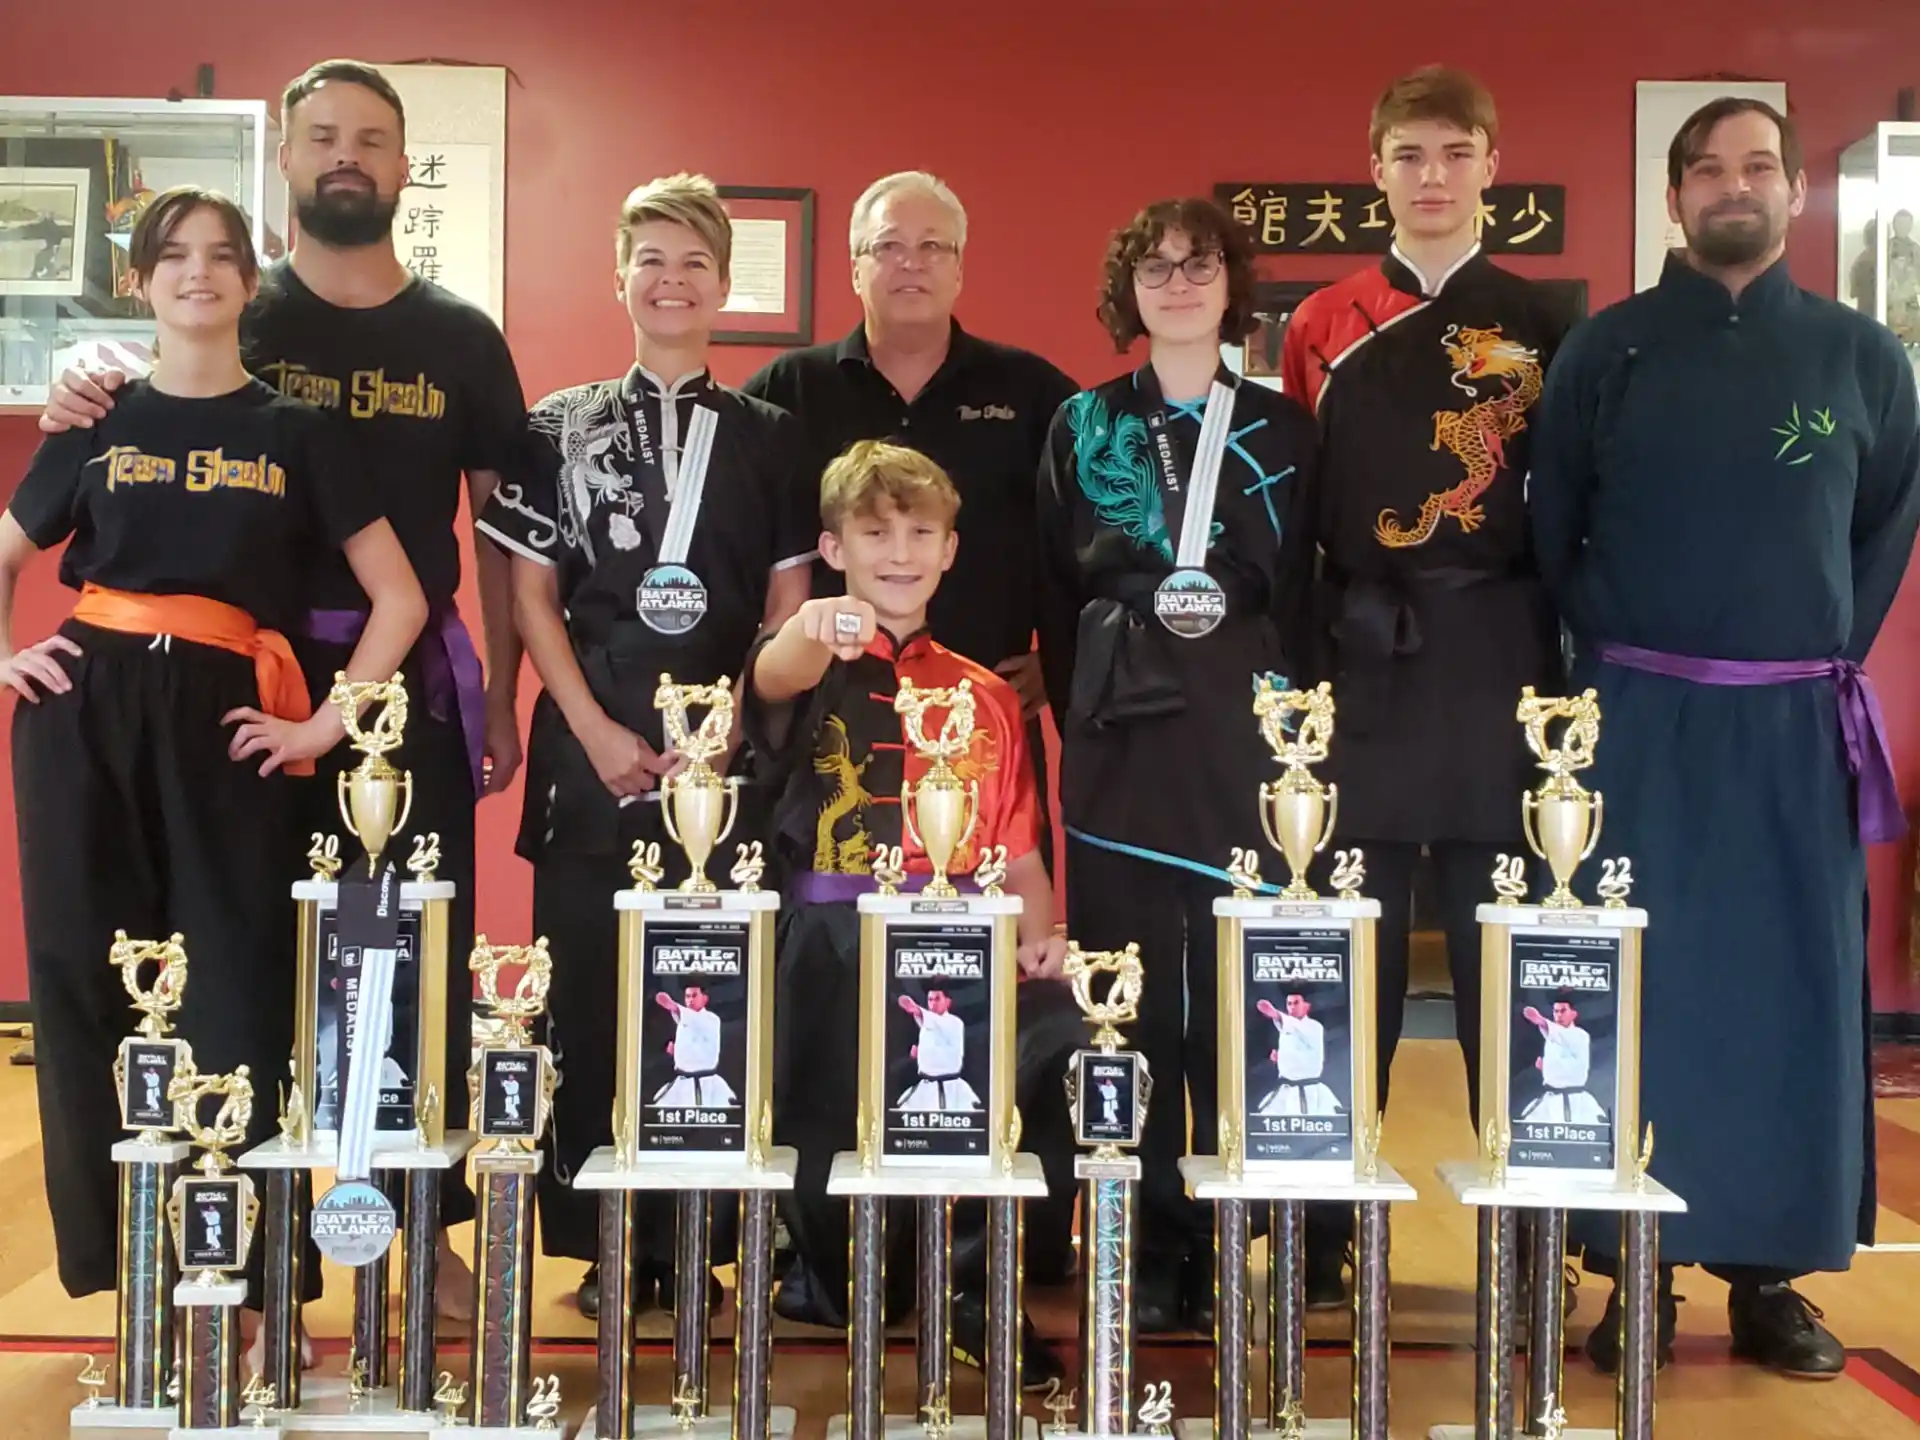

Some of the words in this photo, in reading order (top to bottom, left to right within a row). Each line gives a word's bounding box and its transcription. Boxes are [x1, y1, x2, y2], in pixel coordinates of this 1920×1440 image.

[634, 409, 655, 465] MEDALIST
[85, 445, 176, 494] Team
[1156, 433, 1180, 492] MEDALIST
[641, 590, 692, 599] BATTLE
[1159, 594, 1210, 603] BATTLE
[640, 600, 705, 608] ATLANTA
[1157, 603, 1223, 612] ATLANTA
[306, 832, 339, 859] 20
[410, 832, 443, 860] 22
[627, 839, 661, 867] 20
[734, 840, 766, 869] 22
[872, 843, 903, 872] 20
[978, 844, 1008, 873] 22
[1226, 847, 1258, 875] 20
[1333, 848, 1366, 876] 22
[1491, 853, 1525, 882] 20
[1600, 857, 1635, 885] 22
[376, 872, 392, 917] Discover
[657, 949, 722, 960] BATTLE
[722, 952, 735, 960] OF
[900, 952, 964, 963] BATTLE
[965, 955, 978, 963] OF
[1257, 956, 1323, 967] BATTLE
[655, 960, 738, 972] ATLANTA
[898, 963, 980, 975] ATLANTA
[1255, 968, 1340, 979] ATLANTA
[1525, 963, 1592, 976] BATTLE
[1523, 975, 1608, 988] ATLANTA
[346, 978, 358, 1057] MEDALIS
[657, 1109, 681, 1123] 1st
[684, 1109, 728, 1123] Place
[901, 1113, 926, 1127] 1st
[928, 1113, 972, 1128] Place
[1262, 1118, 1287, 1132] 1st
[1290, 1118, 1334, 1132] Place
[1526, 1125, 1550, 1139] 1st
[1553, 1126, 1597, 1140] Place
[316, 1214, 377, 1224] BATTLE
[314, 1225, 393, 1235] ATLANTA
[77, 1353, 110, 1385] 2nd
[241, 1372, 276, 1404] 4th
[433, 1370, 469, 1404] 2nd
[529, 1374, 562, 1404] 22
[1142, 1381, 1175, 1407] 22
